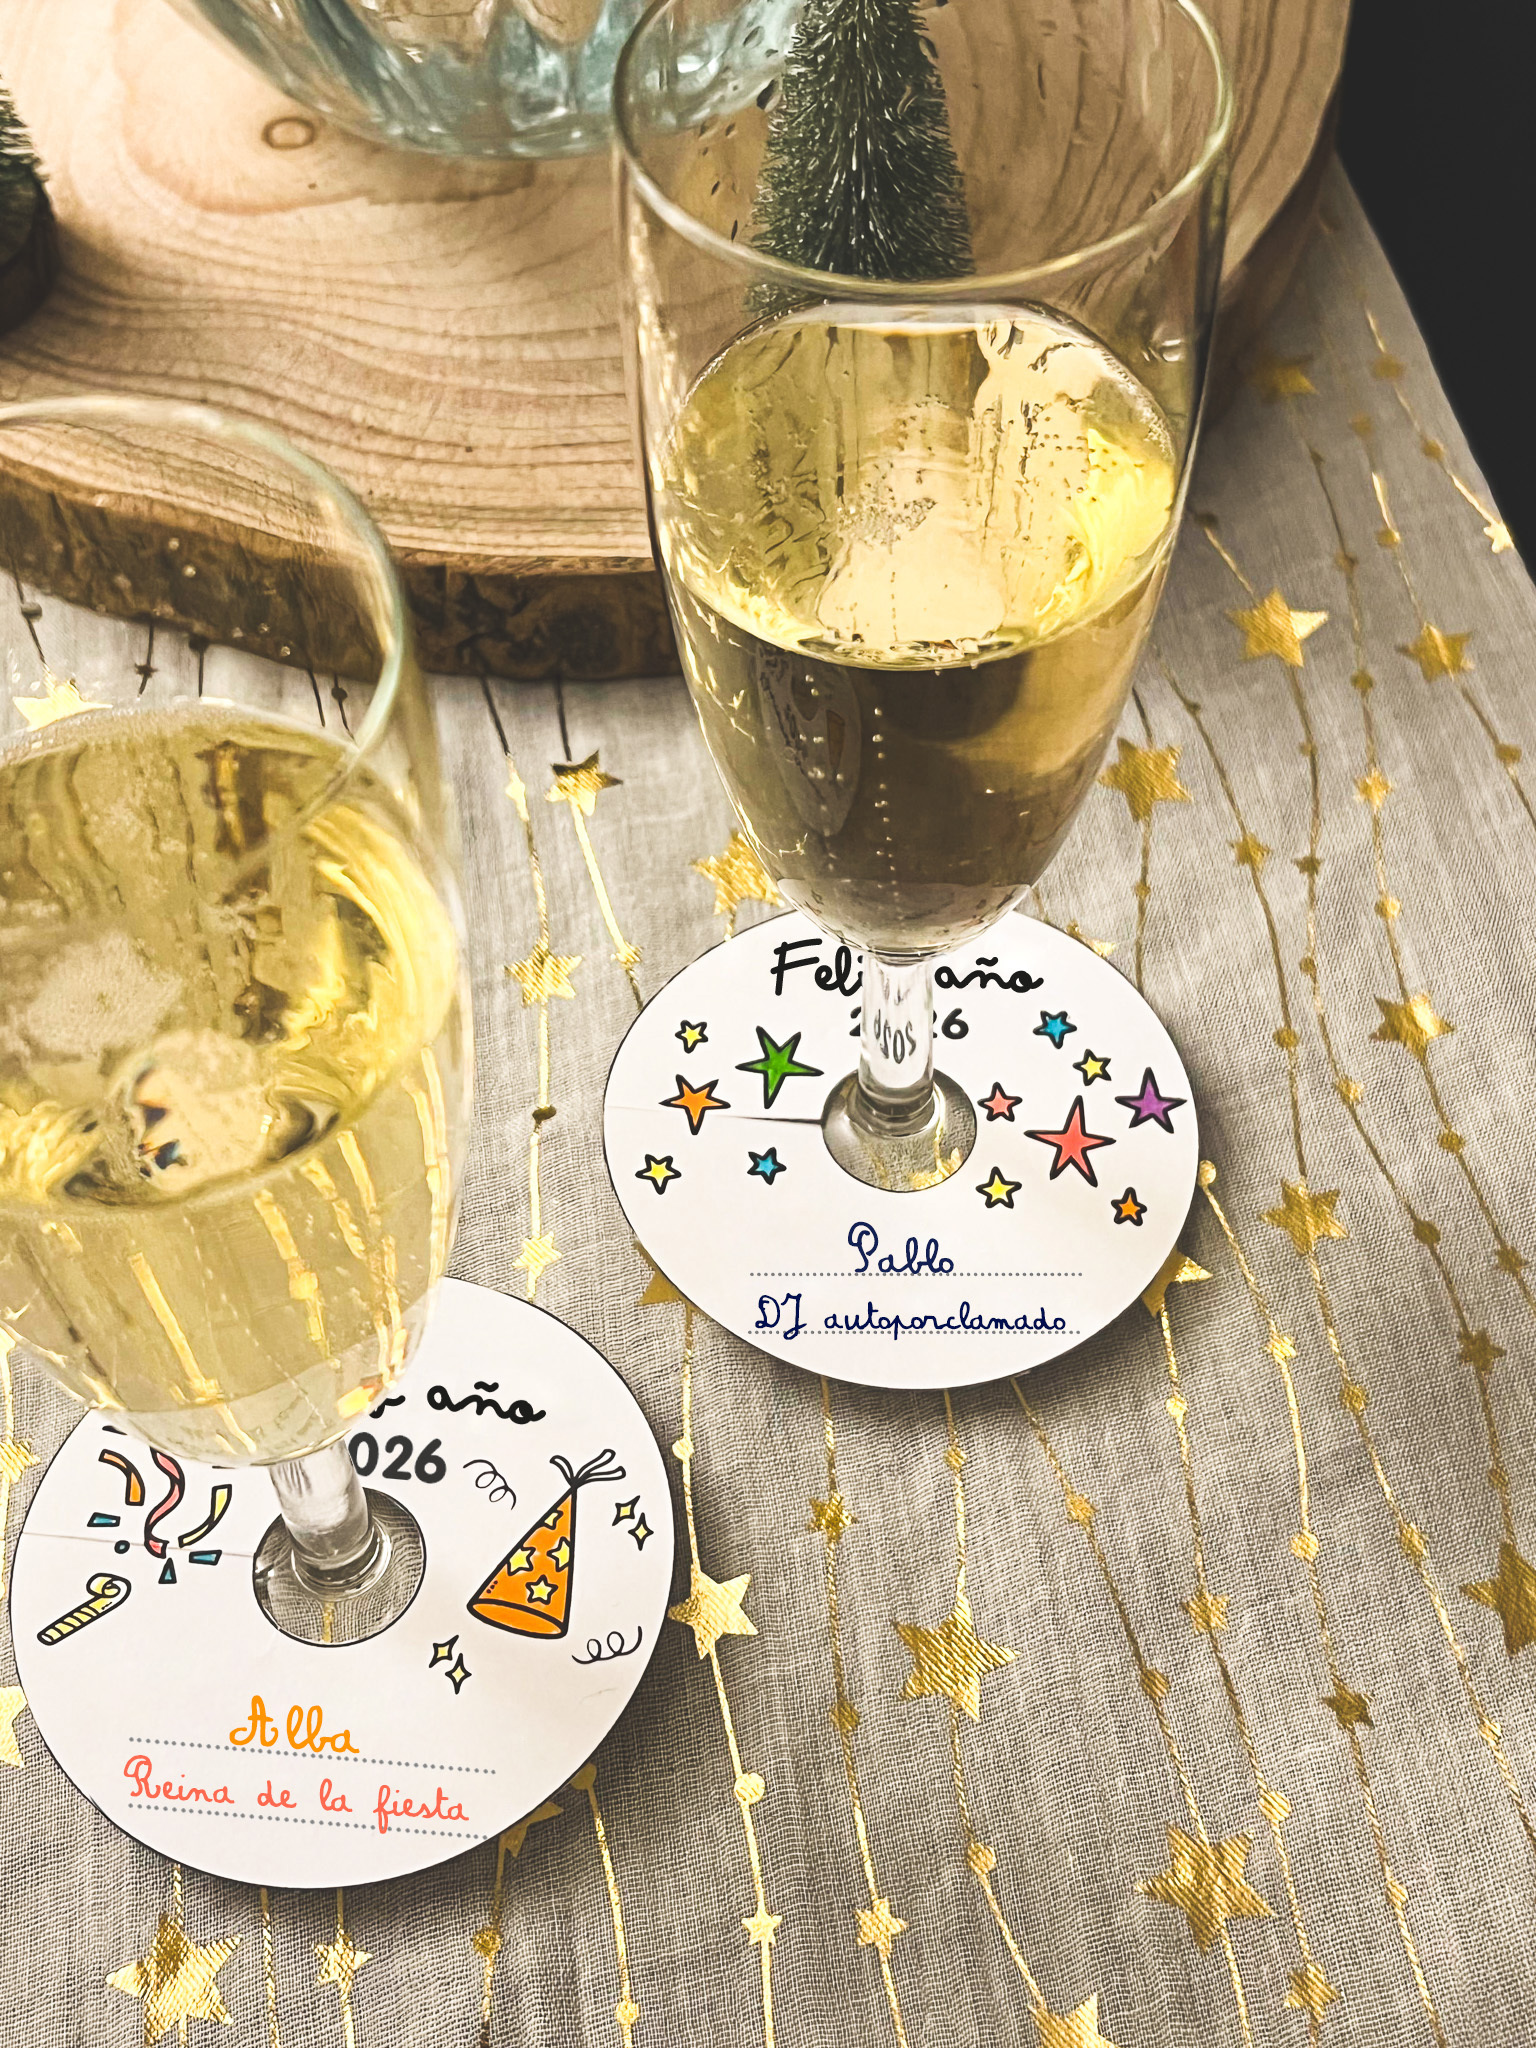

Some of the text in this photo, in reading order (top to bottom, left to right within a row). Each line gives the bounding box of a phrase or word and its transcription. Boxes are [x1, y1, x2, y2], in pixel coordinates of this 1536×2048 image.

[770, 938, 864, 996] Feli
[934, 956, 1044, 993] año
[847, 1221, 955, 1274] Pablo
[755, 1293, 1067, 1341] DJ autoporclamado
[427, 1381, 547, 1425] año
[348, 1431, 447, 1484] 026
[229, 1695, 360, 1753] Alba
[123, 1754, 469, 1834] Reina de la fiesta
